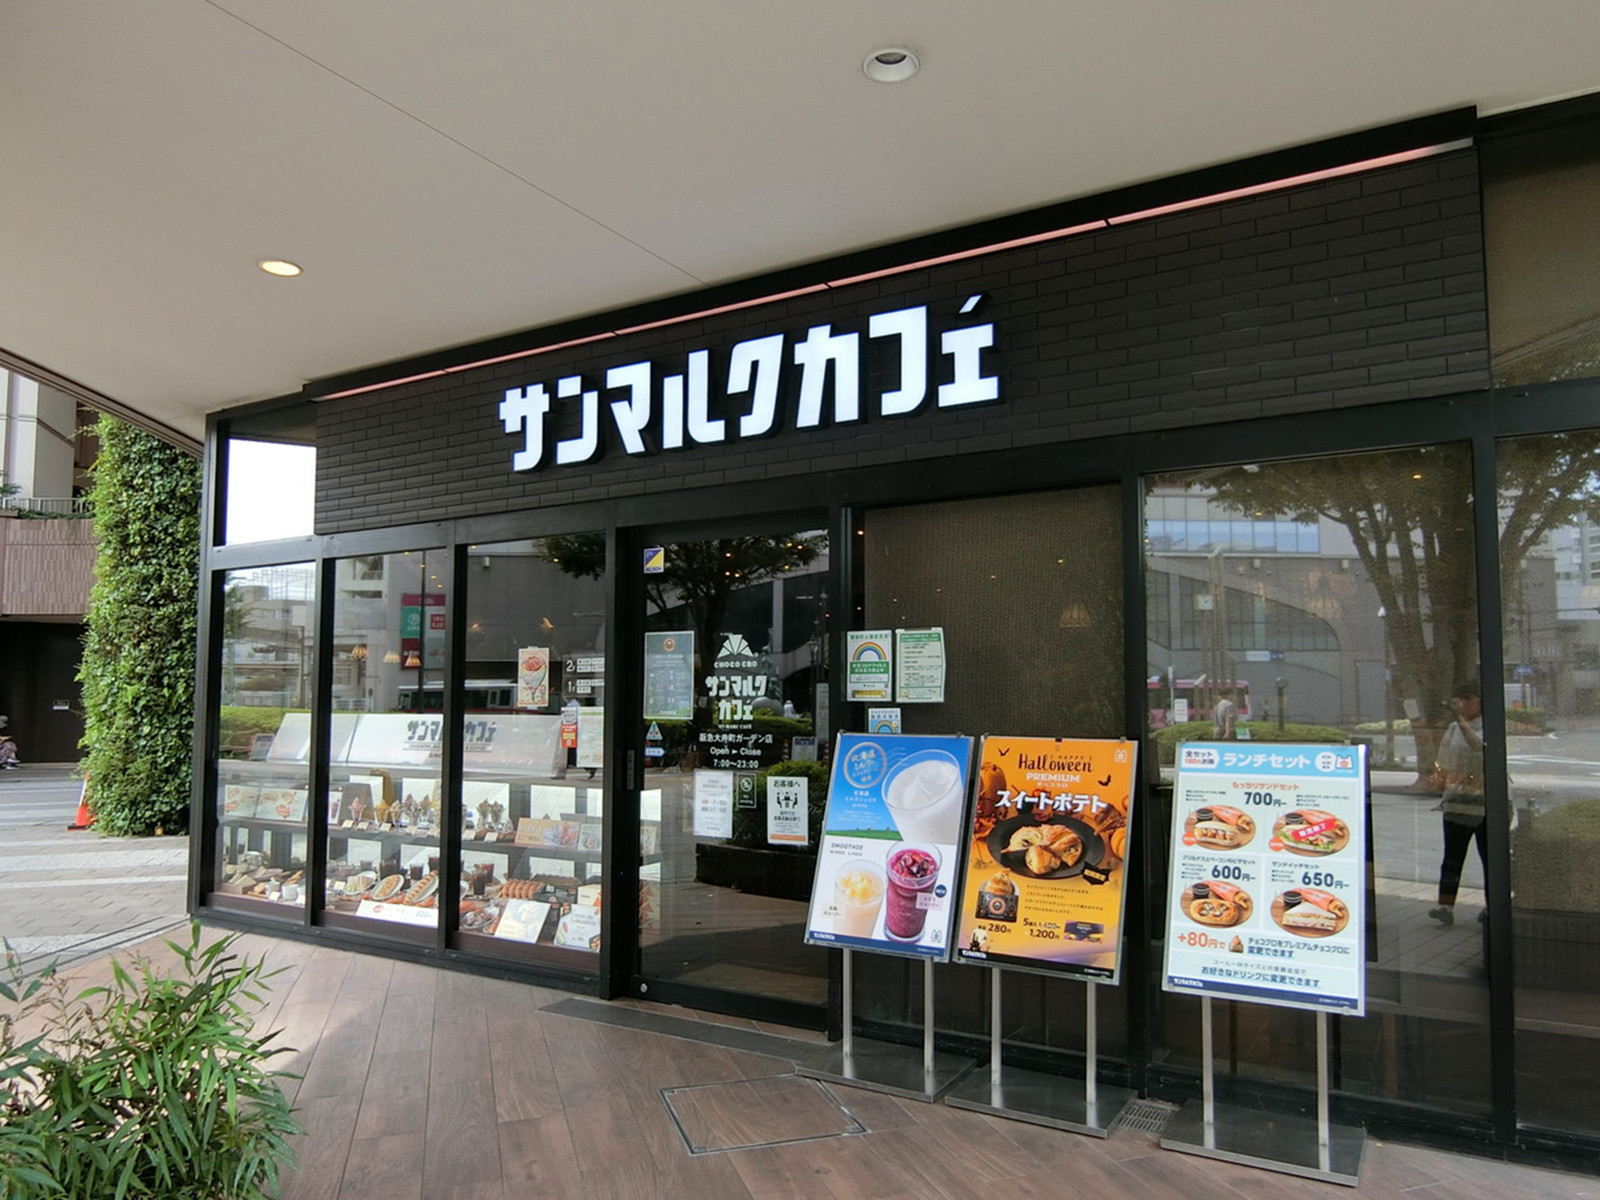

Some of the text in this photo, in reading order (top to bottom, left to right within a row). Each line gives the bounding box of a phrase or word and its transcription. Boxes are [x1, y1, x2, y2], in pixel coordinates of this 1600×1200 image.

[498, 294, 999, 472] サンマルクカフェ
[705, 675, 768, 697] サンマルク
[718, 699, 754, 721] カフェ
[699, 733, 773, 743] 阪急大井町ガーデン店
[710, 746, 762, 756] Open Close
[1018, 753, 1093, 772] Halloween
[1223, 752, 1310, 769] ランチセット
[1026, 772, 1080, 782] PREMIUM
[994, 790, 1107, 813] スイートポテト
[831, 842, 863, 850] SMOOTHIE
[1247, 946, 1294, 959] 変更できます
[1201, 966, 1320, 987] お好きなドリンクに変更できます
